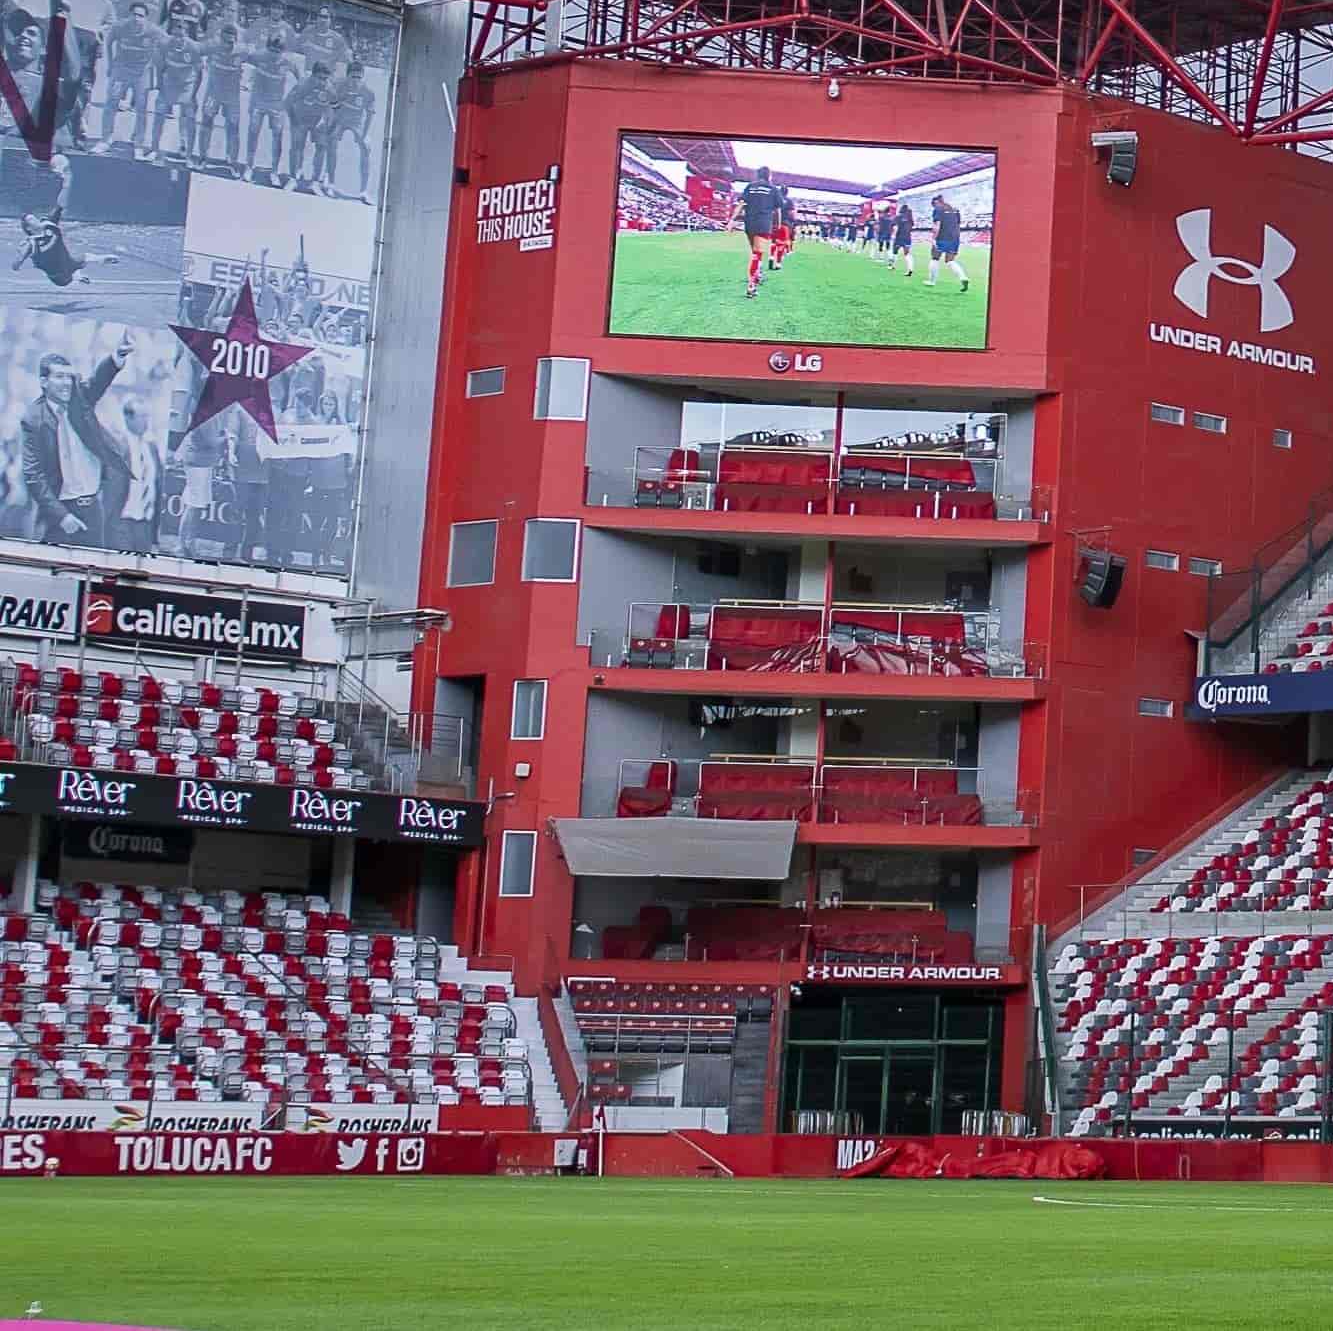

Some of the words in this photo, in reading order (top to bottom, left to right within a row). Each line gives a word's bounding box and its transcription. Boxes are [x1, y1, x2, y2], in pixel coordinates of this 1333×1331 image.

[478, 179, 555, 218] PROTECT
[477, 218, 503, 244] THIS
[503, 210, 555, 240] HOUSE
[210, 338, 270, 380] 2010
[794, 353, 822, 371] LG
[1150, 323, 1222, 354] UNDER
[1226, 340, 1316, 375] ARMOUR
[117, 603, 300, 650] caliente.mx
[1199, 679, 1271, 712] Corona
[833, 966, 904, 979] UNDER
[907, 966, 1000, 979] ARMOUR
